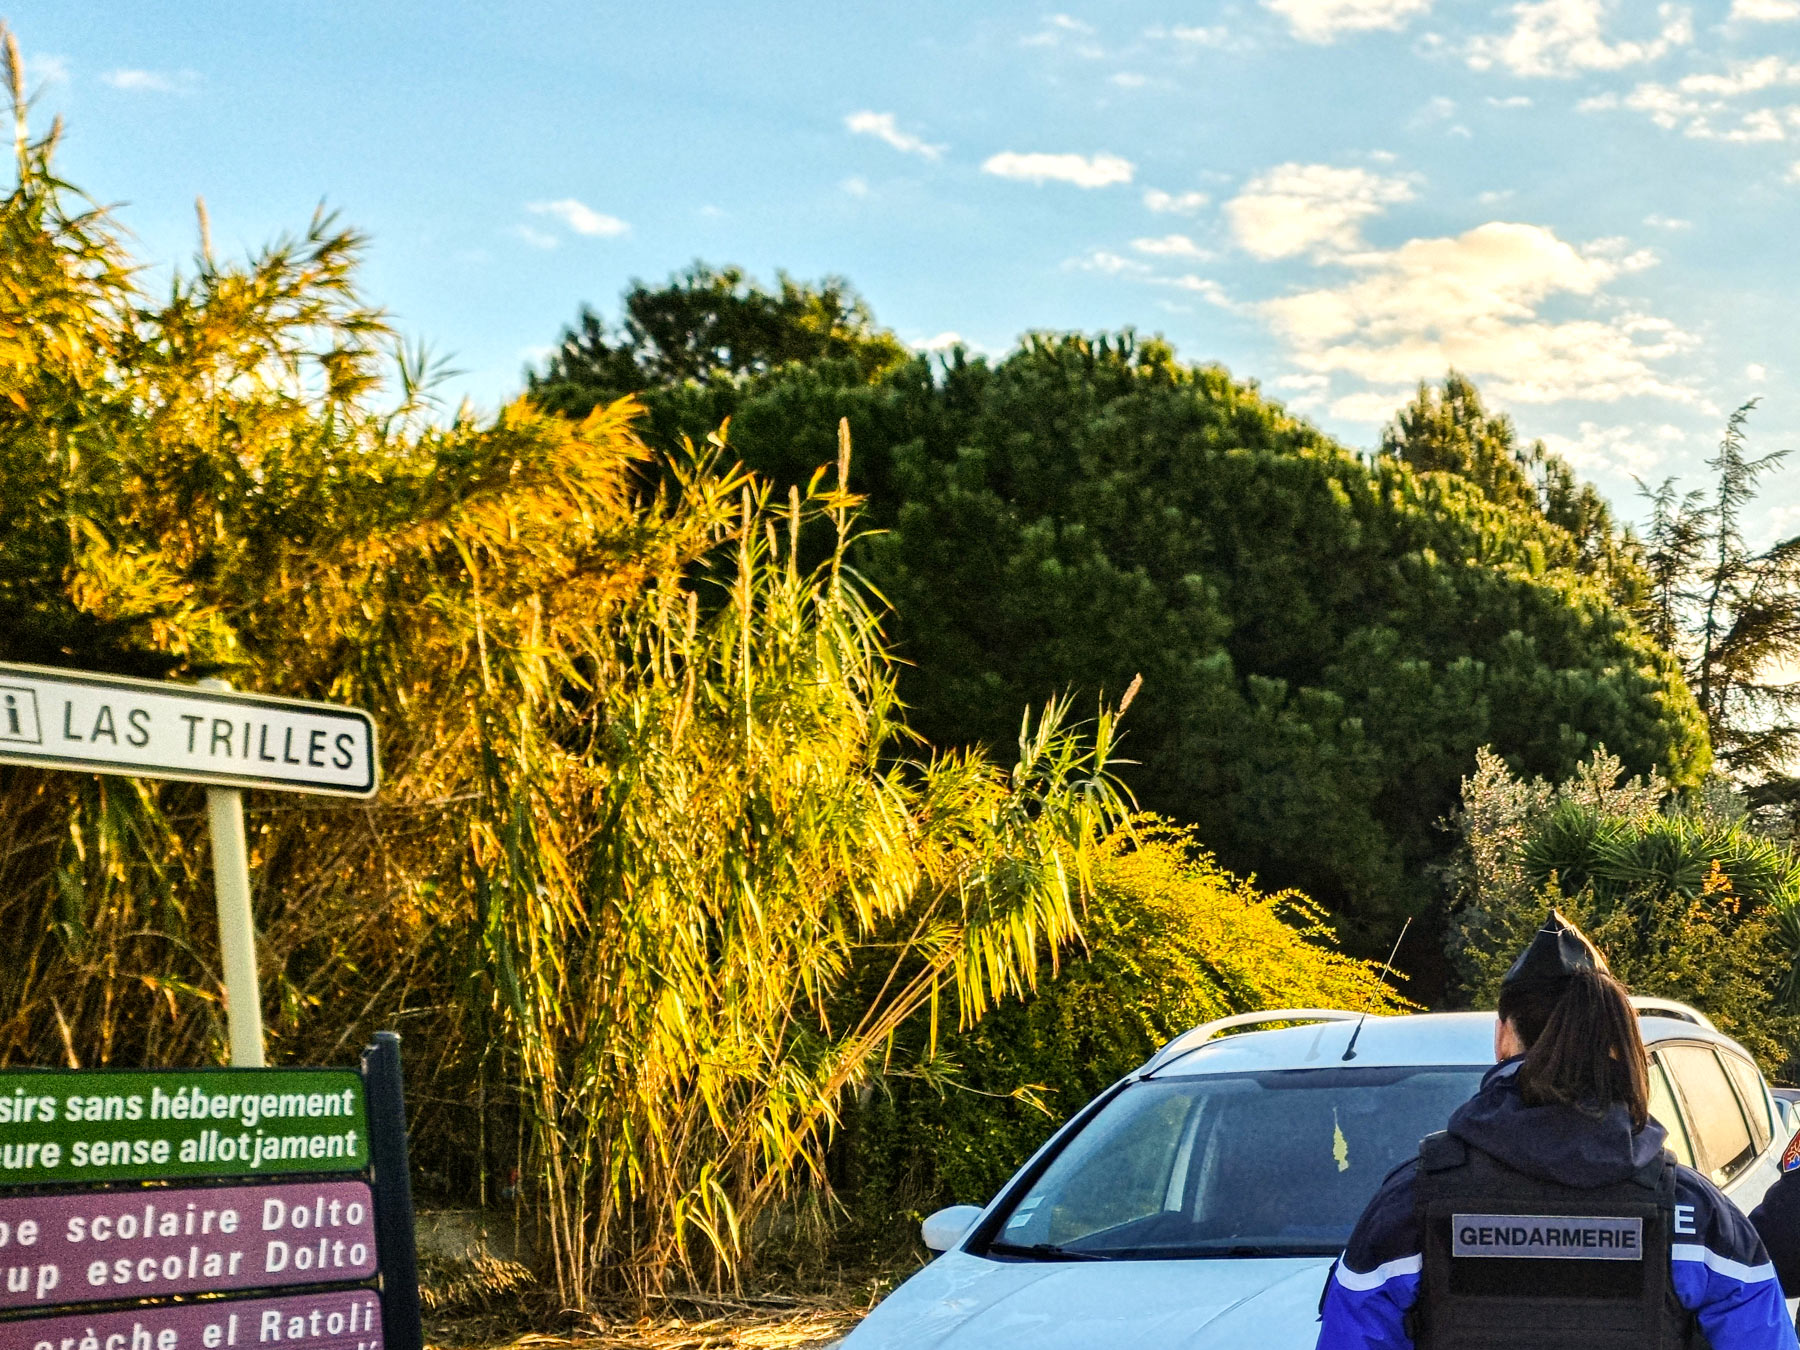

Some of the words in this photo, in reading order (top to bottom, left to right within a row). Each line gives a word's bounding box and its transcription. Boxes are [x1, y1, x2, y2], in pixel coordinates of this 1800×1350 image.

[63, 699, 152, 748] LAS
[180, 714, 355, 770] TRILLES
[64, 1095, 144, 1122] sans
[150, 1086, 355, 1127] hébergement
[0, 1141, 62, 1170] ure
[70, 1139, 171, 1168] sense
[178, 1128, 358, 1168] allotjament
[66, 1203, 240, 1243] scolaire
[262, 1196, 364, 1231] Dolto
[1459, 1226, 1638, 1249] GENDARMERIE
[0, 1262, 60, 1300] up
[87, 1246, 244, 1286] escolar
[265, 1237, 367, 1273] Dolto
[202, 1313, 238, 1349] el
[259, 1301, 374, 1343] Ratoli
